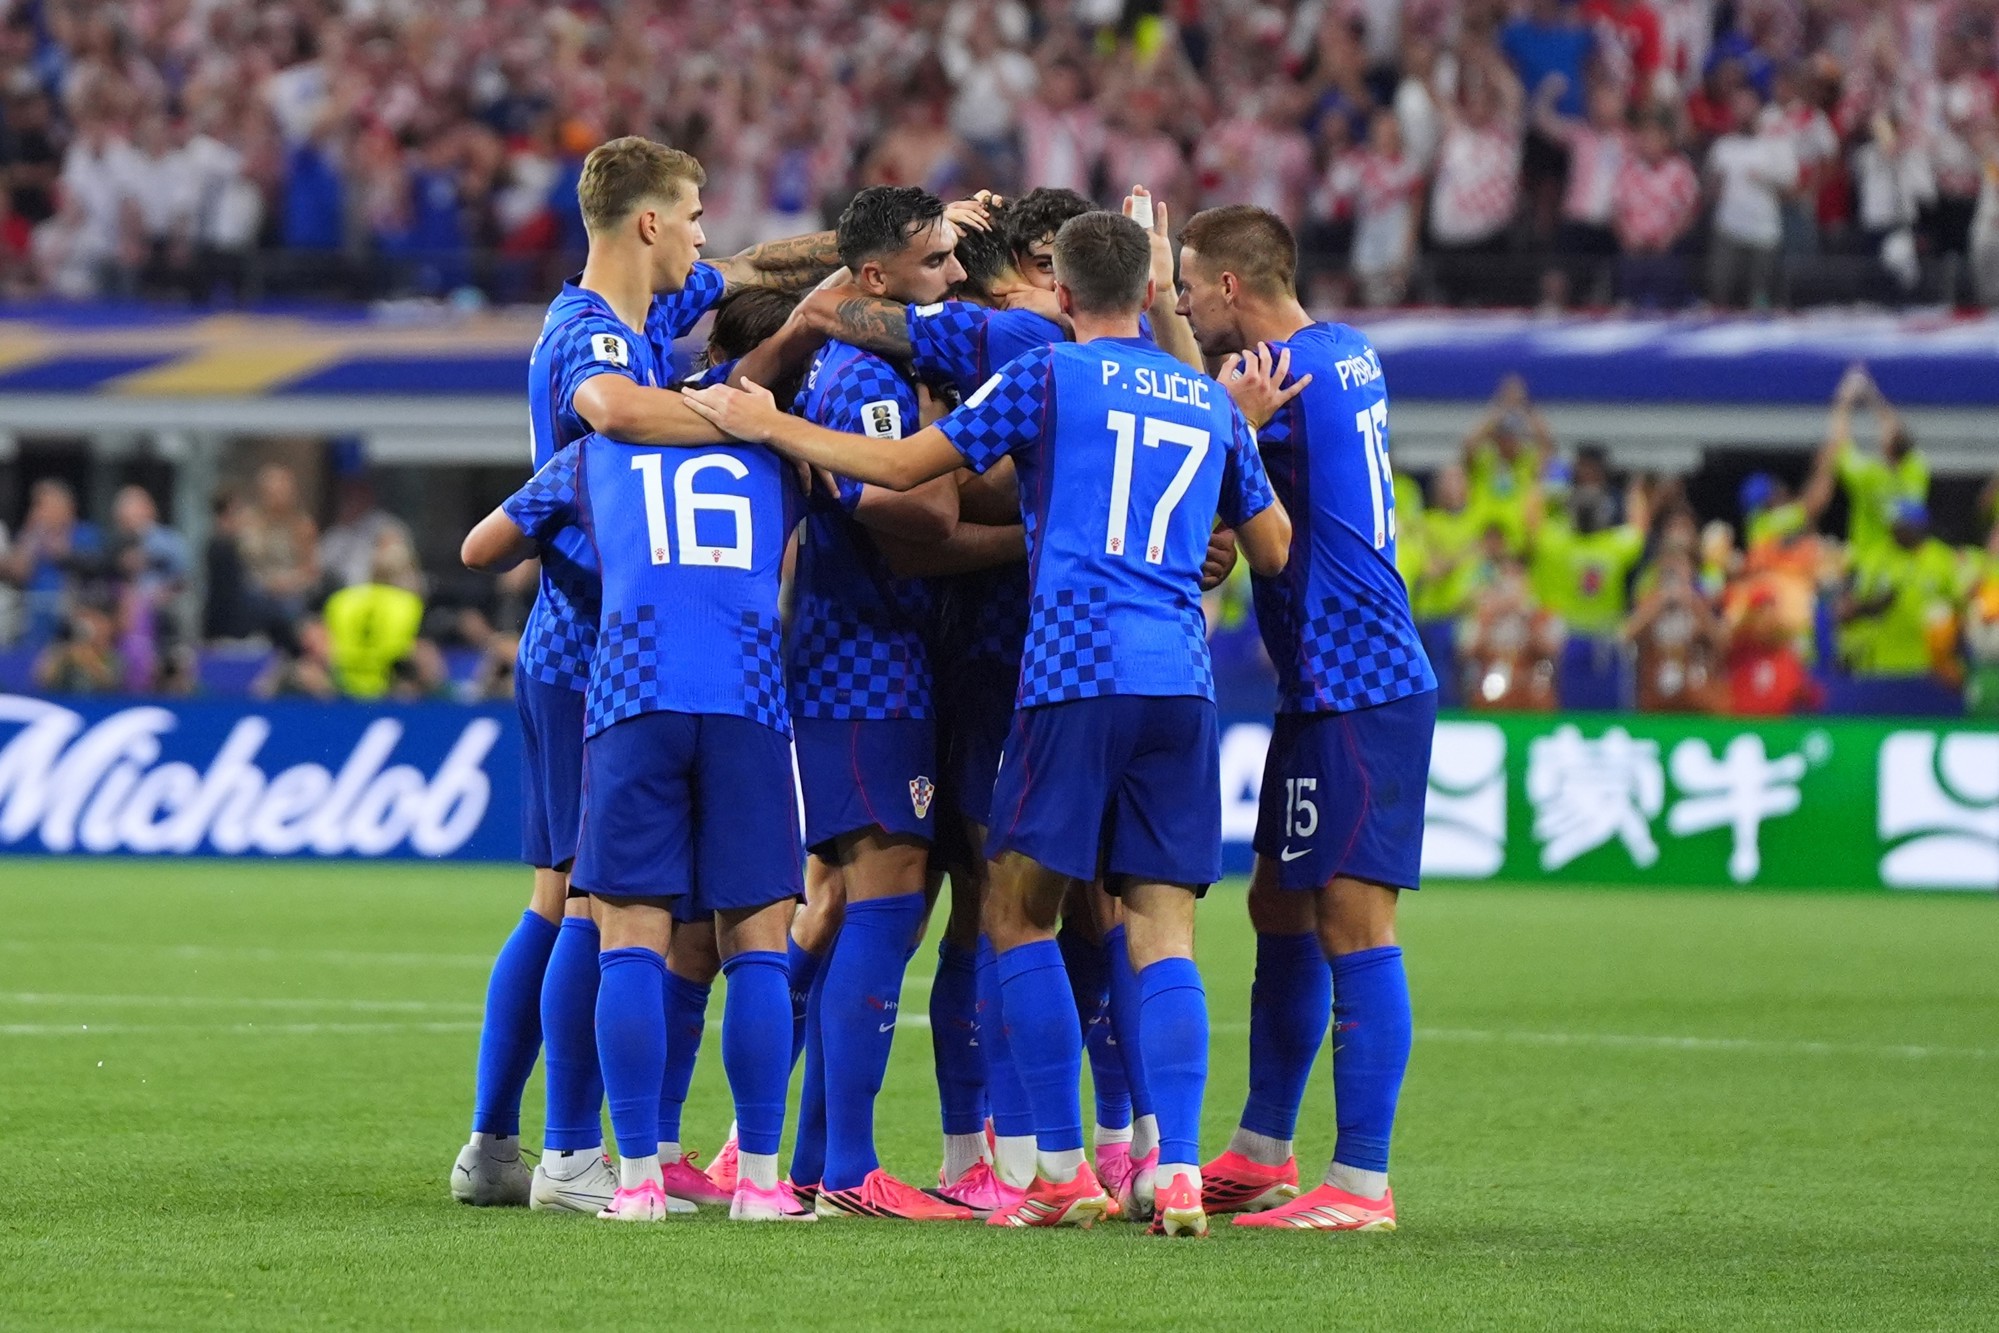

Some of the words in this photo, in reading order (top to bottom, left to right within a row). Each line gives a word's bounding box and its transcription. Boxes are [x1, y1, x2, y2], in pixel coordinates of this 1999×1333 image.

[1101, 359, 1128, 390] P.
[630, 453, 753, 571] 16
[1105, 409, 1211, 566] 17
[0, 693, 500, 855] Michelob
[1285, 778, 1319, 838] 15
